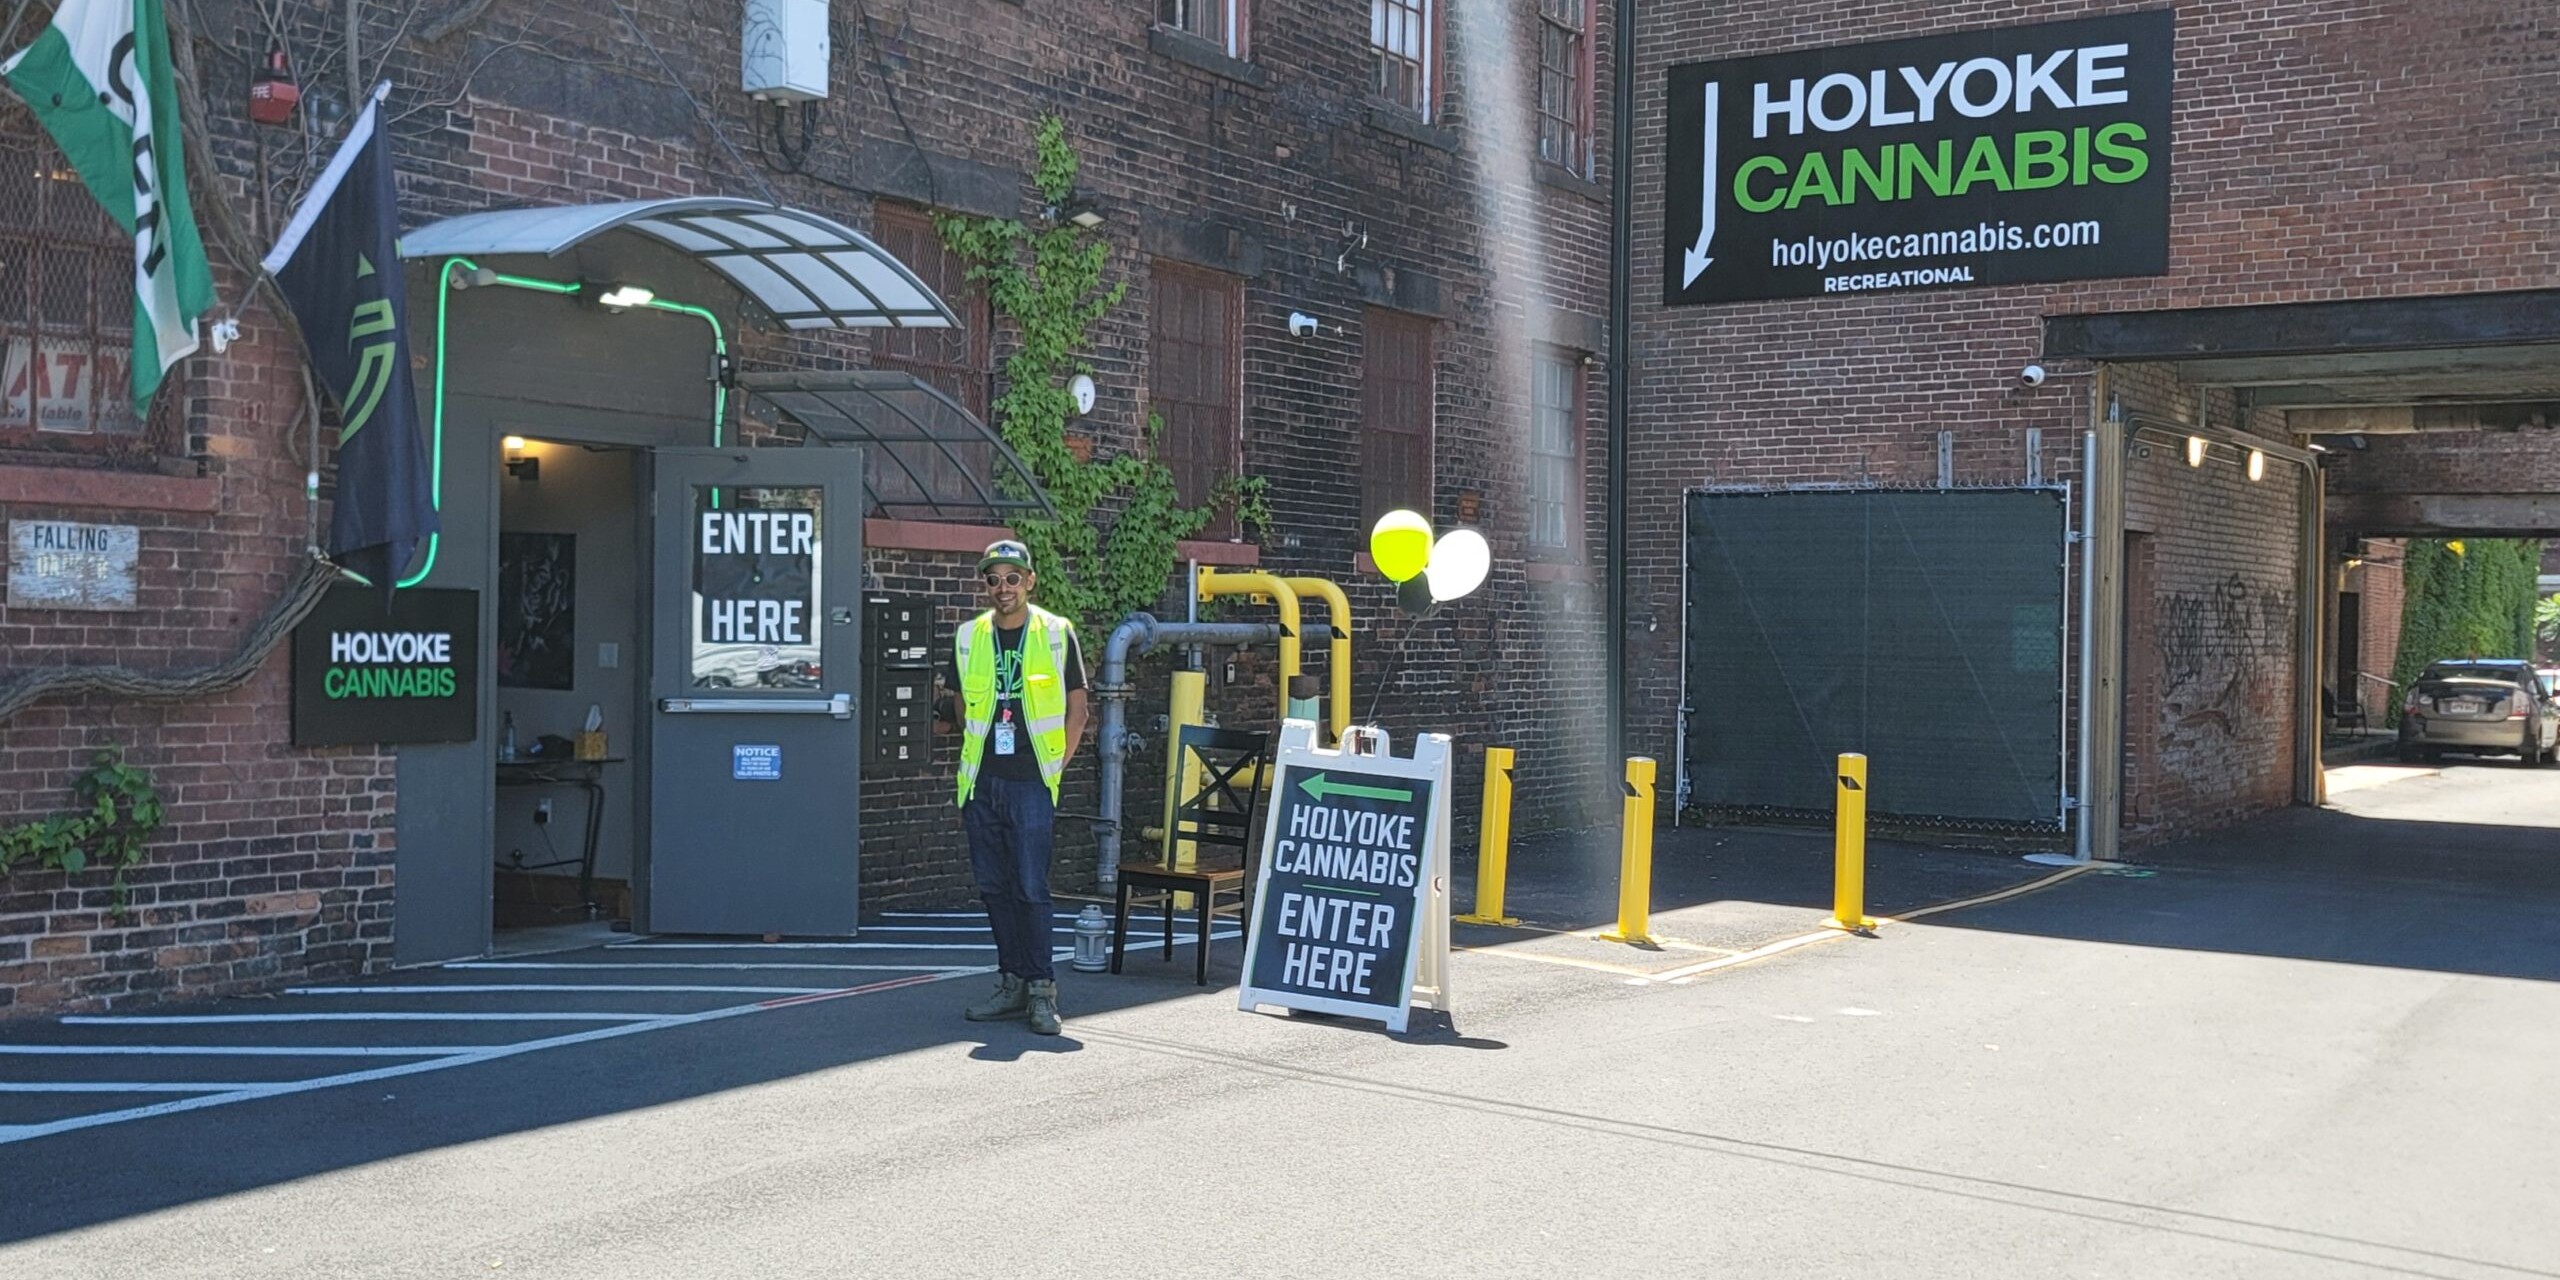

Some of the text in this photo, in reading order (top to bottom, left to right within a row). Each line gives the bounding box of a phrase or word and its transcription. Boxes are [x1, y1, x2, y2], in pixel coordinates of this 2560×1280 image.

[1752, 43, 2128, 138] HOLYOKE
[108, 31, 166, 279] OEN
[1733, 122, 2149, 213] CANNABIS
[1772, 219, 2101, 270] holyokecannabis.com
[1825, 266, 1974, 292] RECREATIONAL
[8, 352, 134, 400] ATM
[34, 525, 108, 551] FALLING
[702, 512, 813, 555] ENTER
[712, 600, 803, 642] HERE
[331, 632, 451, 663] HOLYOKE
[324, 667, 456, 698] CANNABIS
[736, 748, 779, 757] NOTICE
[1289, 803, 1415, 850] HOLYOKE
[1275, 840, 1417, 888] CANNABIS
[1277, 892, 1395, 949] ENTER
[1282, 943, 1377, 995] HERE
